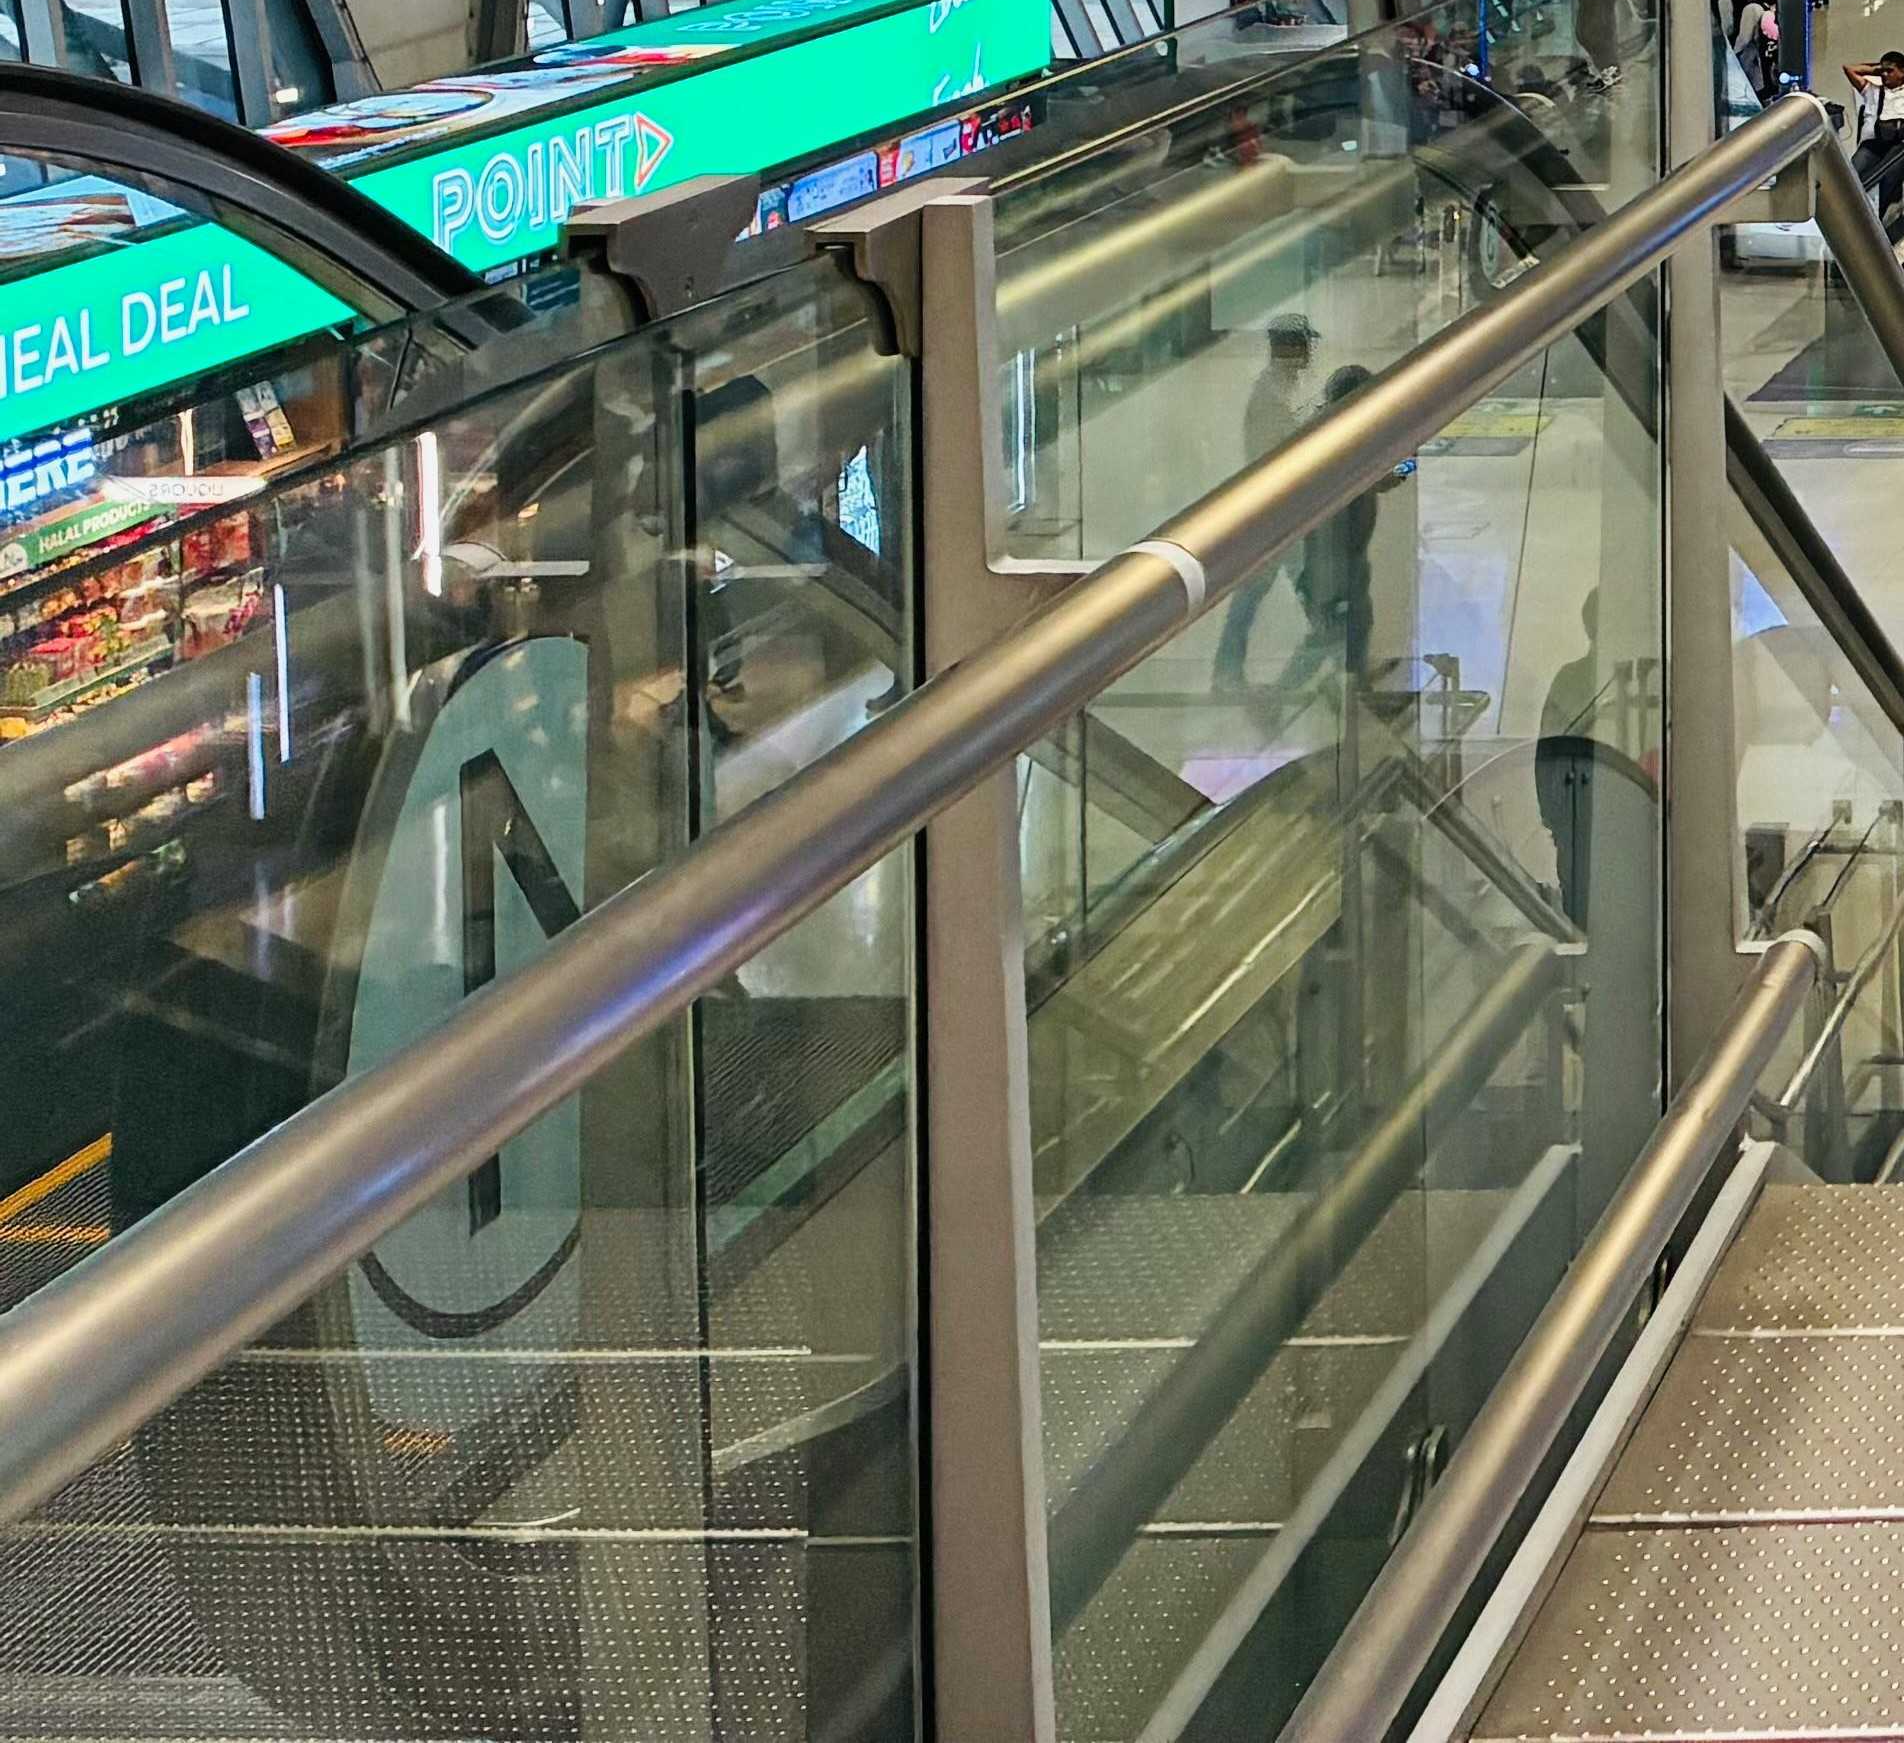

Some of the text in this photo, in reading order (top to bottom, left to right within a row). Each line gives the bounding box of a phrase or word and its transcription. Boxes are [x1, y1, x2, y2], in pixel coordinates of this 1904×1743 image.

[432, 114, 632, 256] POINT
[0, 264, 249, 399] EAL DEAL
[39, 524, 82, 553] HALAL
